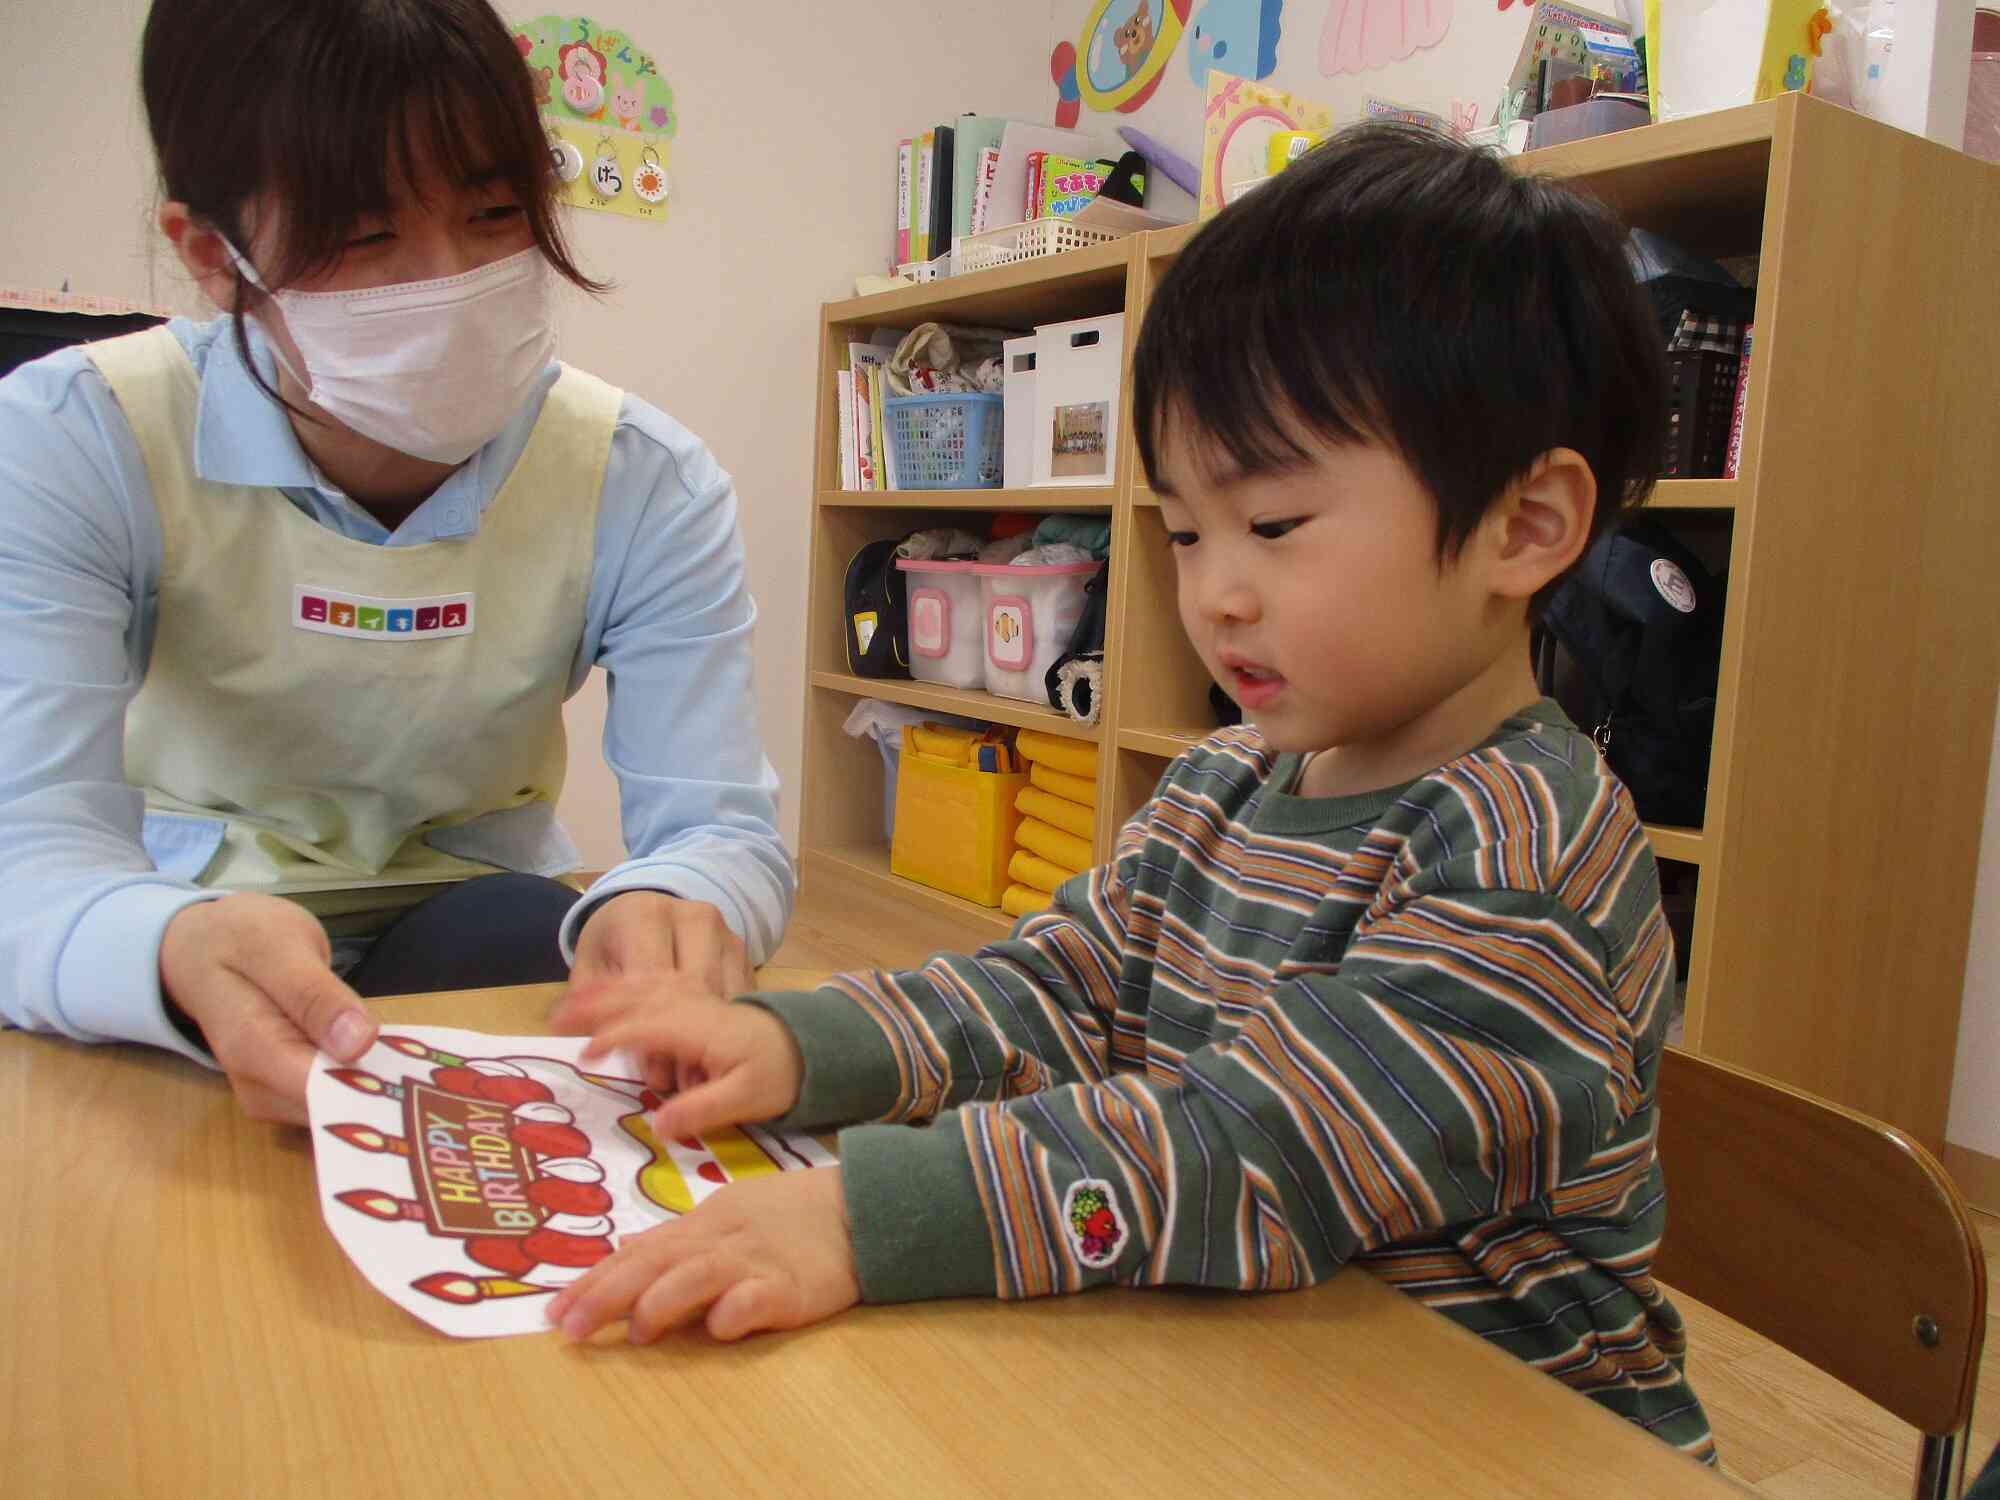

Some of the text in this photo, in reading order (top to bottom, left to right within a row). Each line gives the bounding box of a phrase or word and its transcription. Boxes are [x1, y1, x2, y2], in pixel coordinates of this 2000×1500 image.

[596, 165, 623, 193] げつ
[426, 1111, 482, 1203] HAPPY
[465, 1103, 538, 1228] BIRTHDAY
